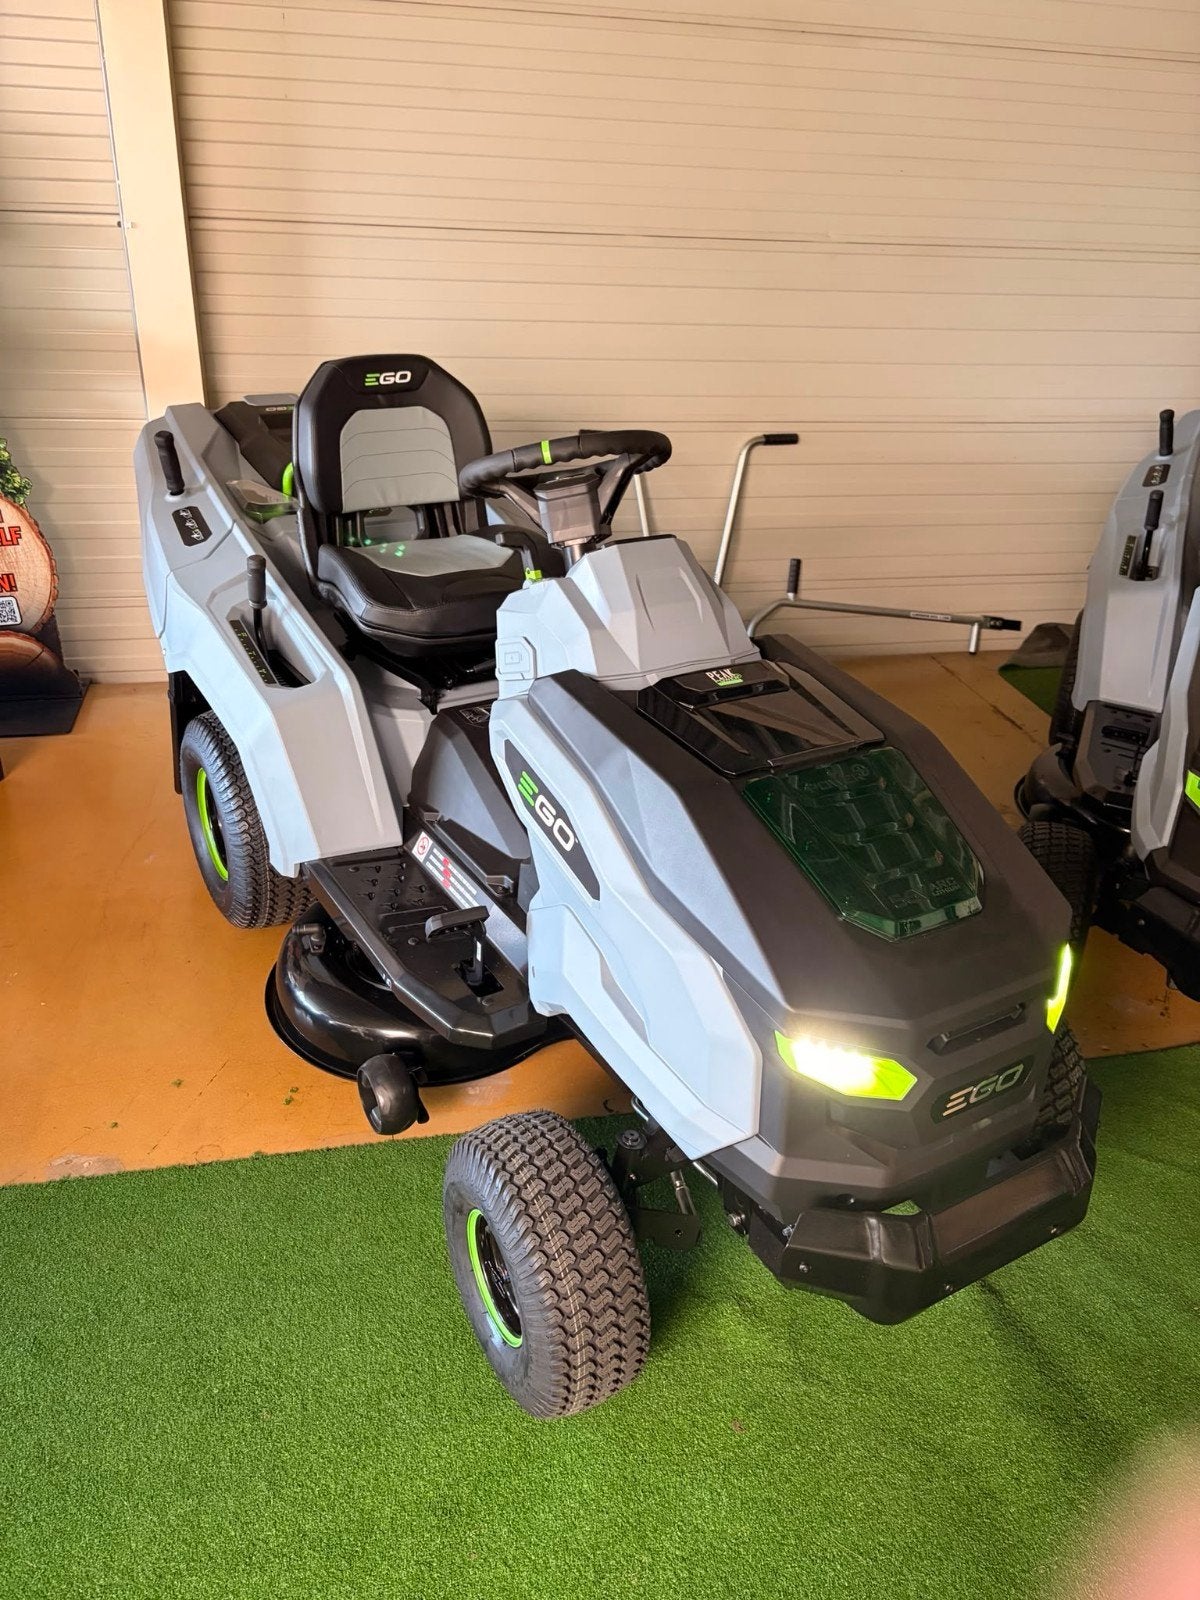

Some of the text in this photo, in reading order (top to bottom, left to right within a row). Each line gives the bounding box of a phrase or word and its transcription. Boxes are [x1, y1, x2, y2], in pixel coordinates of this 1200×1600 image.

[364, 370, 412, 386] EGO
[705, 668, 736, 684] PEAK
[517, 770, 575, 852] EGO
[942, 1063, 1025, 1117] EGO
